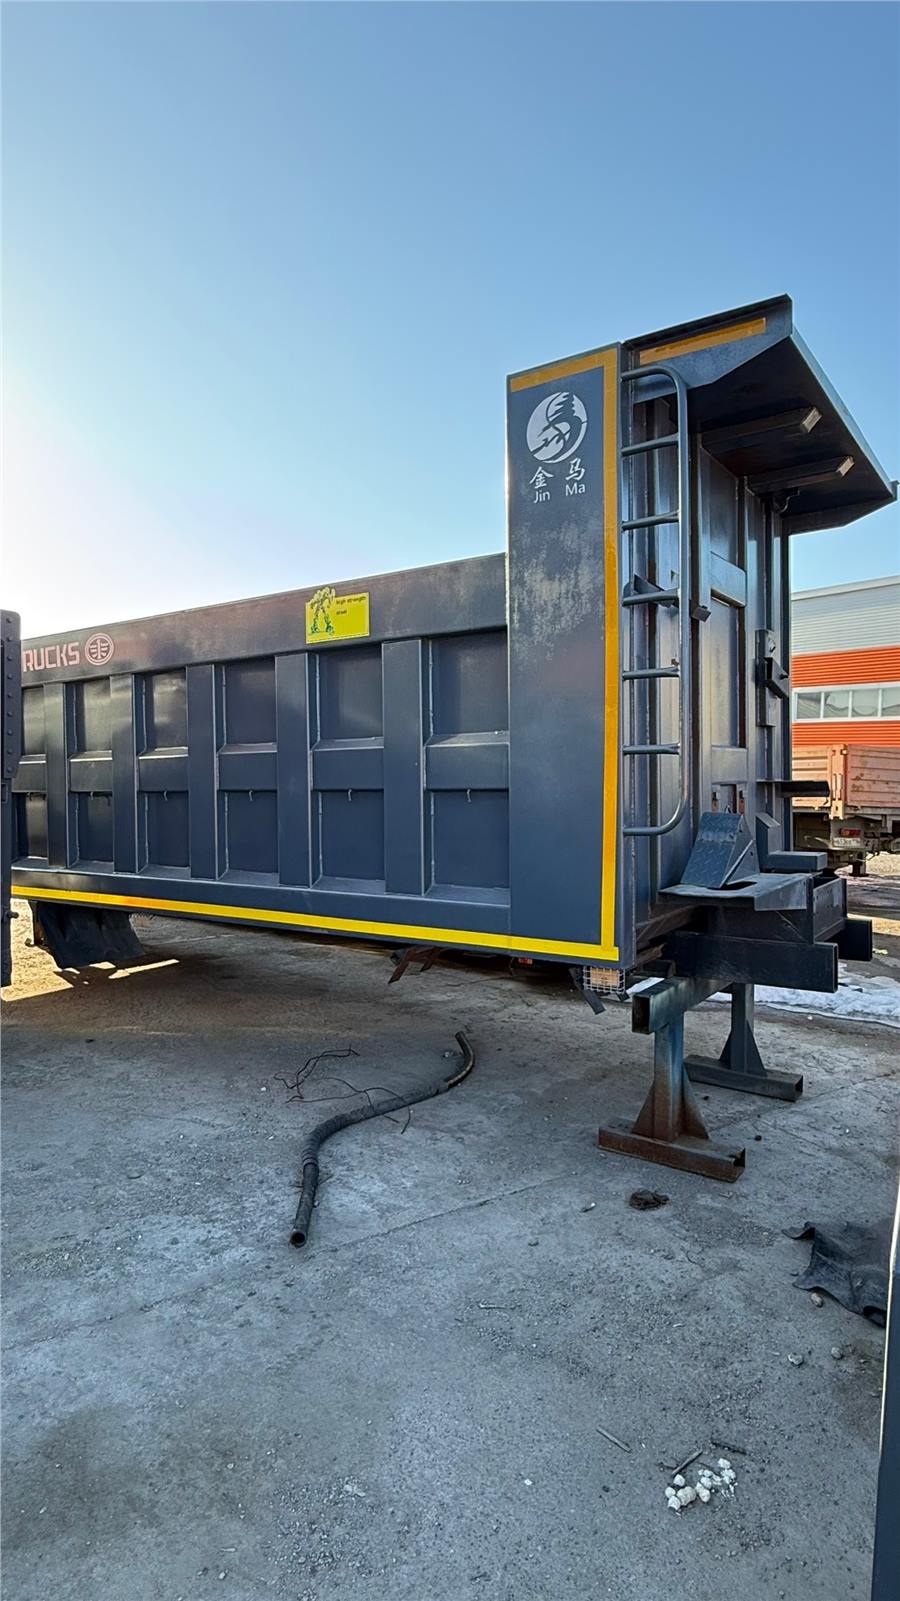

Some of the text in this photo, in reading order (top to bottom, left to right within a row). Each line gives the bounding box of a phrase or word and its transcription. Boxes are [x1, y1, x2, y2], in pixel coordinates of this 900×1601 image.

[529, 457, 586, 489] 金 马
[533, 482, 586, 504] Jin Ma
